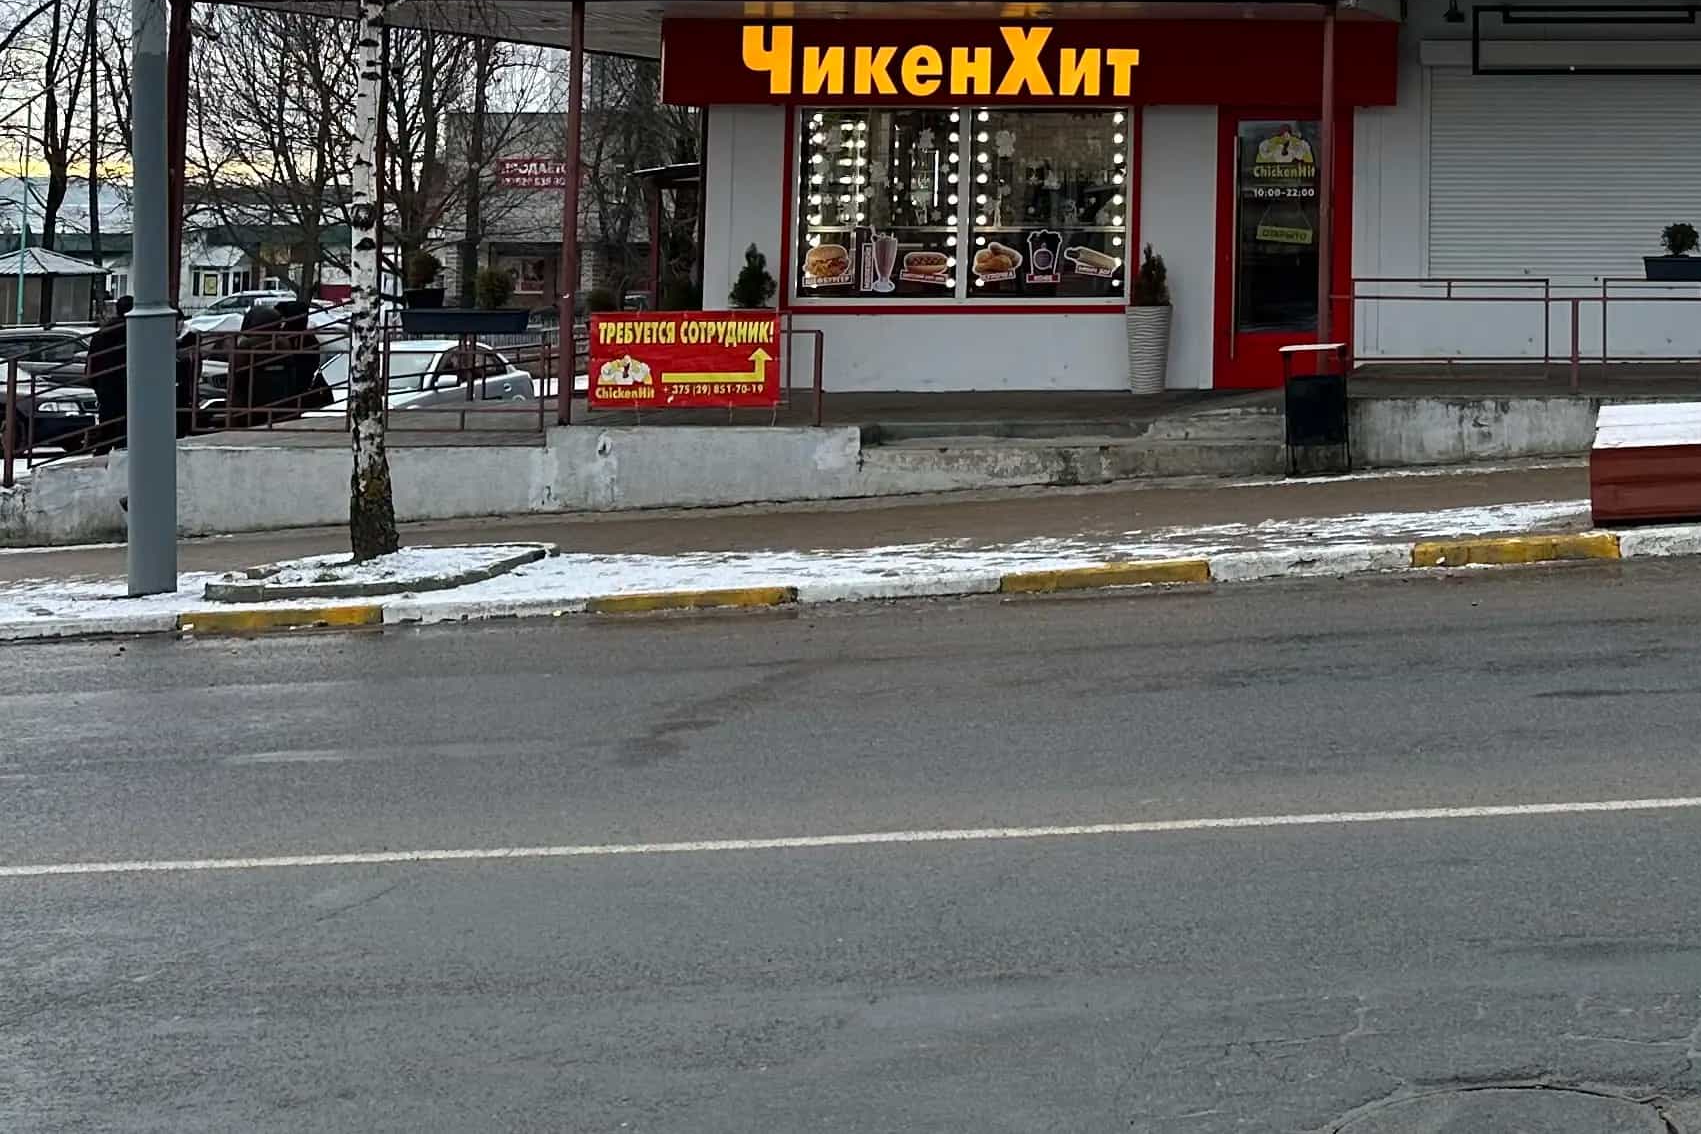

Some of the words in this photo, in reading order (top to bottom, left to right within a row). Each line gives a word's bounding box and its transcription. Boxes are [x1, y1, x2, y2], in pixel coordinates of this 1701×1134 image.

[742, 25, 1140, 96] ЧикенХит
[598, 321, 676, 344] ТРЕБУЕТСЯ
[680, 321, 774, 347] СОТРУДНИК!
[595, 386, 655, 399] ChickenHit
[671, 384, 690, 395] 375
